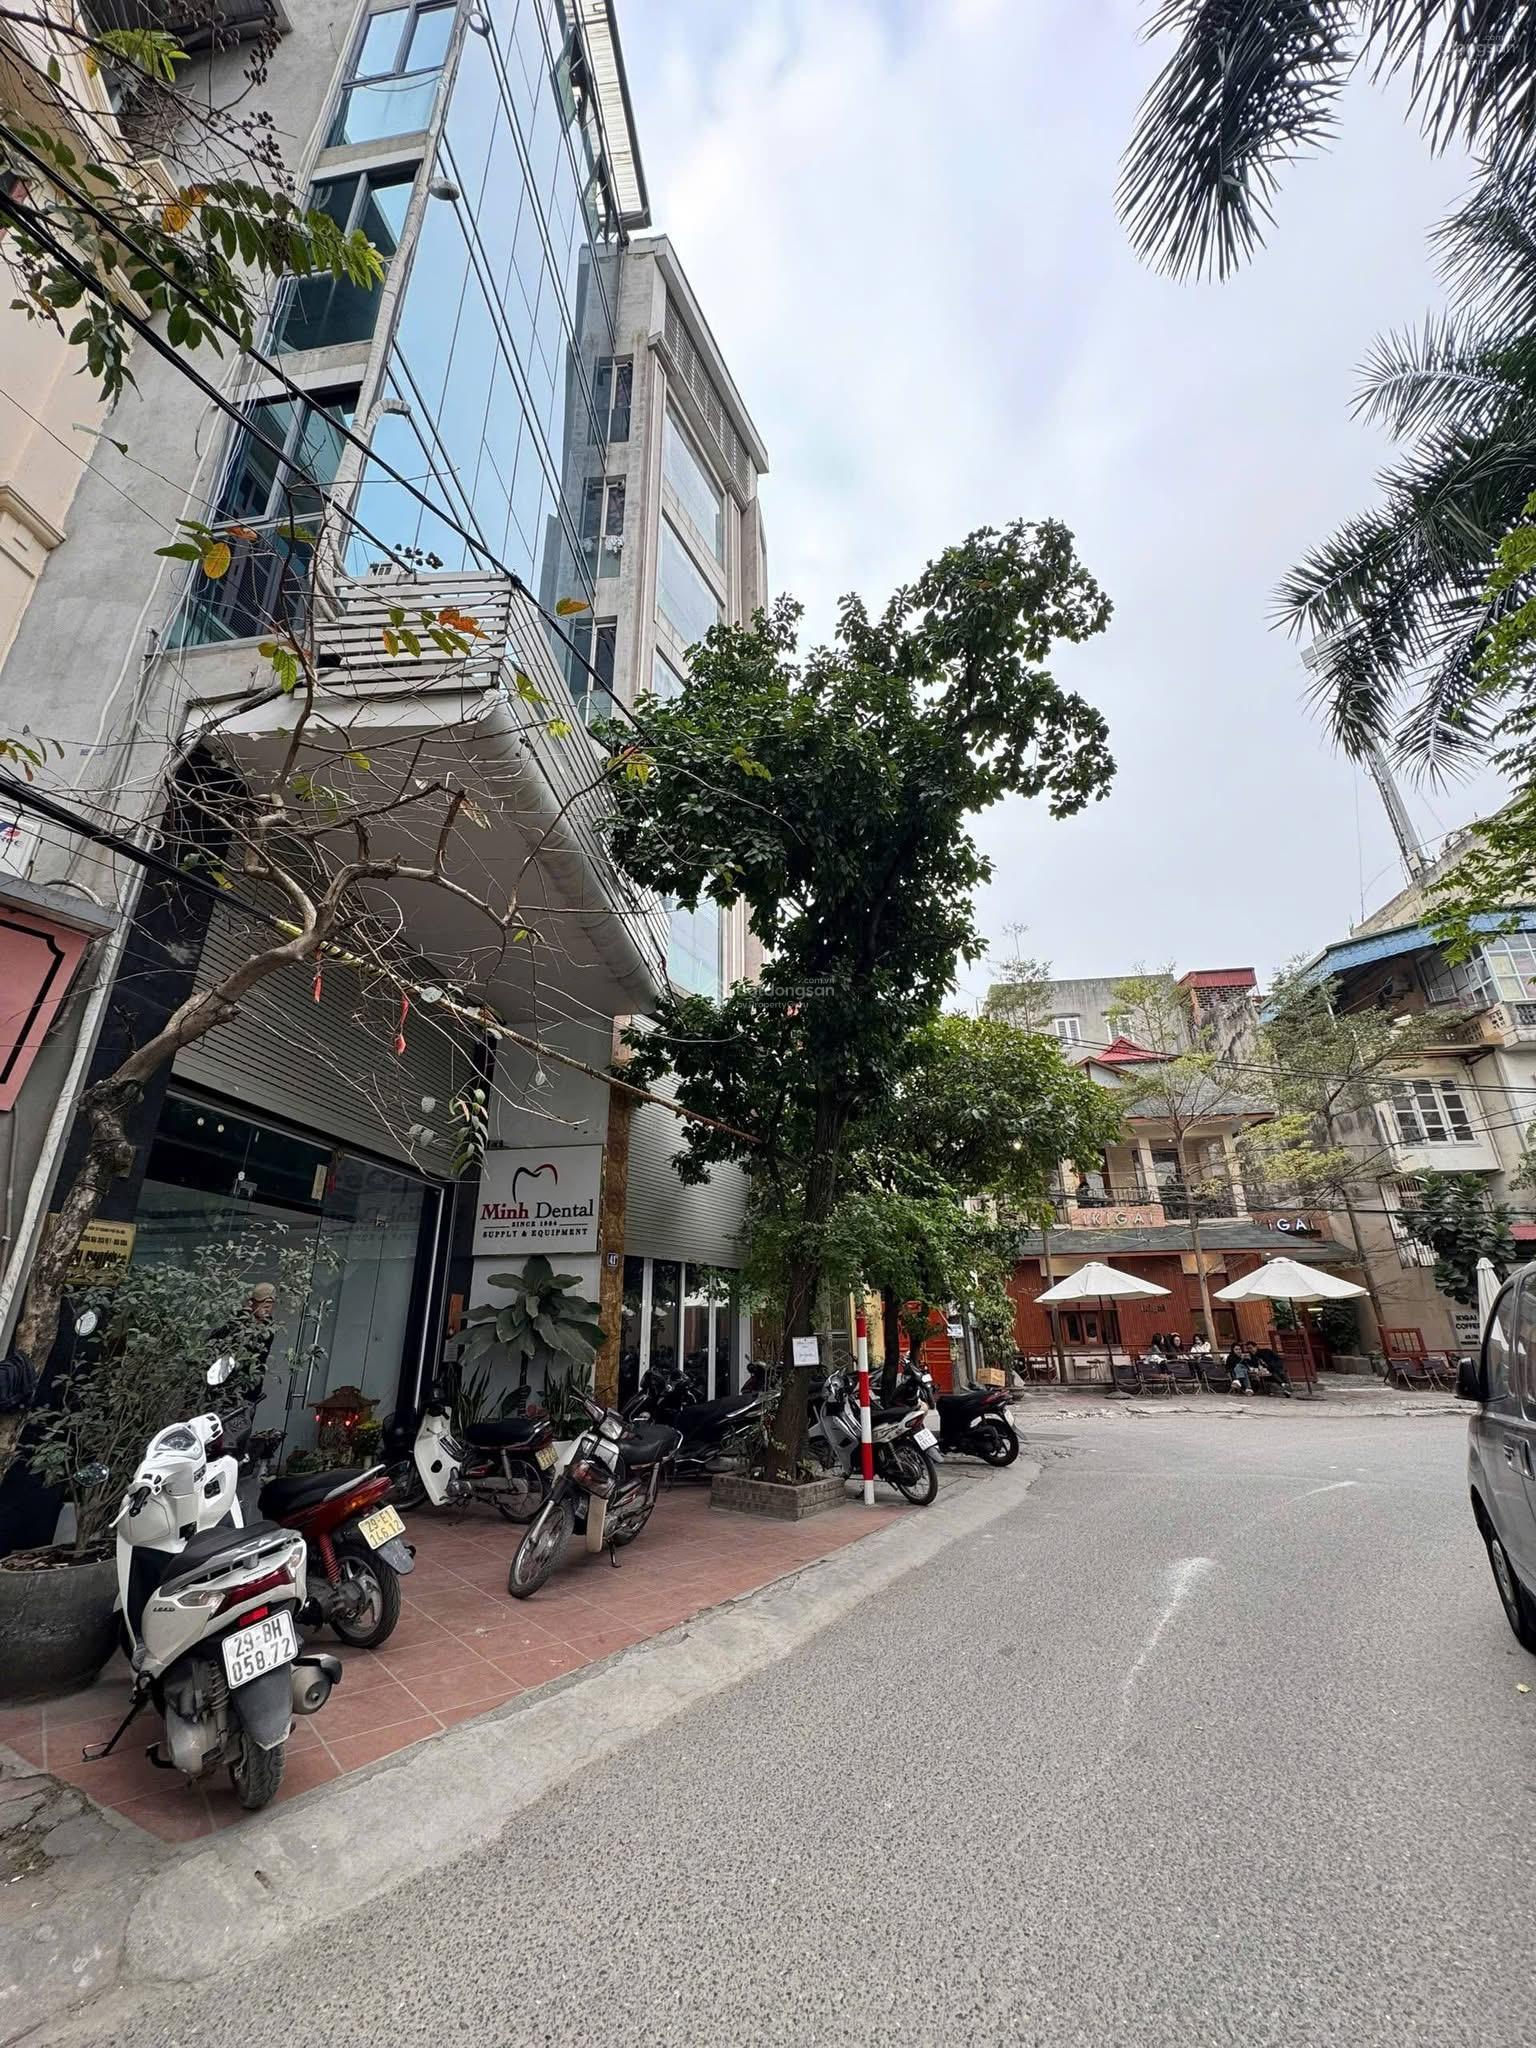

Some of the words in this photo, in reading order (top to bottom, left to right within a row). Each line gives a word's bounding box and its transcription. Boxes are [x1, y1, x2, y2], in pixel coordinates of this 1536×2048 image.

[480, 1202, 529, 1220] Minh
[535, 1199, 594, 1219] Dental
[1083, 1211, 1153, 1226] IKIGAI
[482, 1230, 518, 1238] SUPPLY
[531, 1228, 588, 1238] EQUIPMENT
[511, 1220, 536, 1228] SINCE
[365, 1510, 393, 1533] 29-E1
[234, 1618, 283, 1659] 29-BH
[231, 1637, 293, 1683] 058.72
